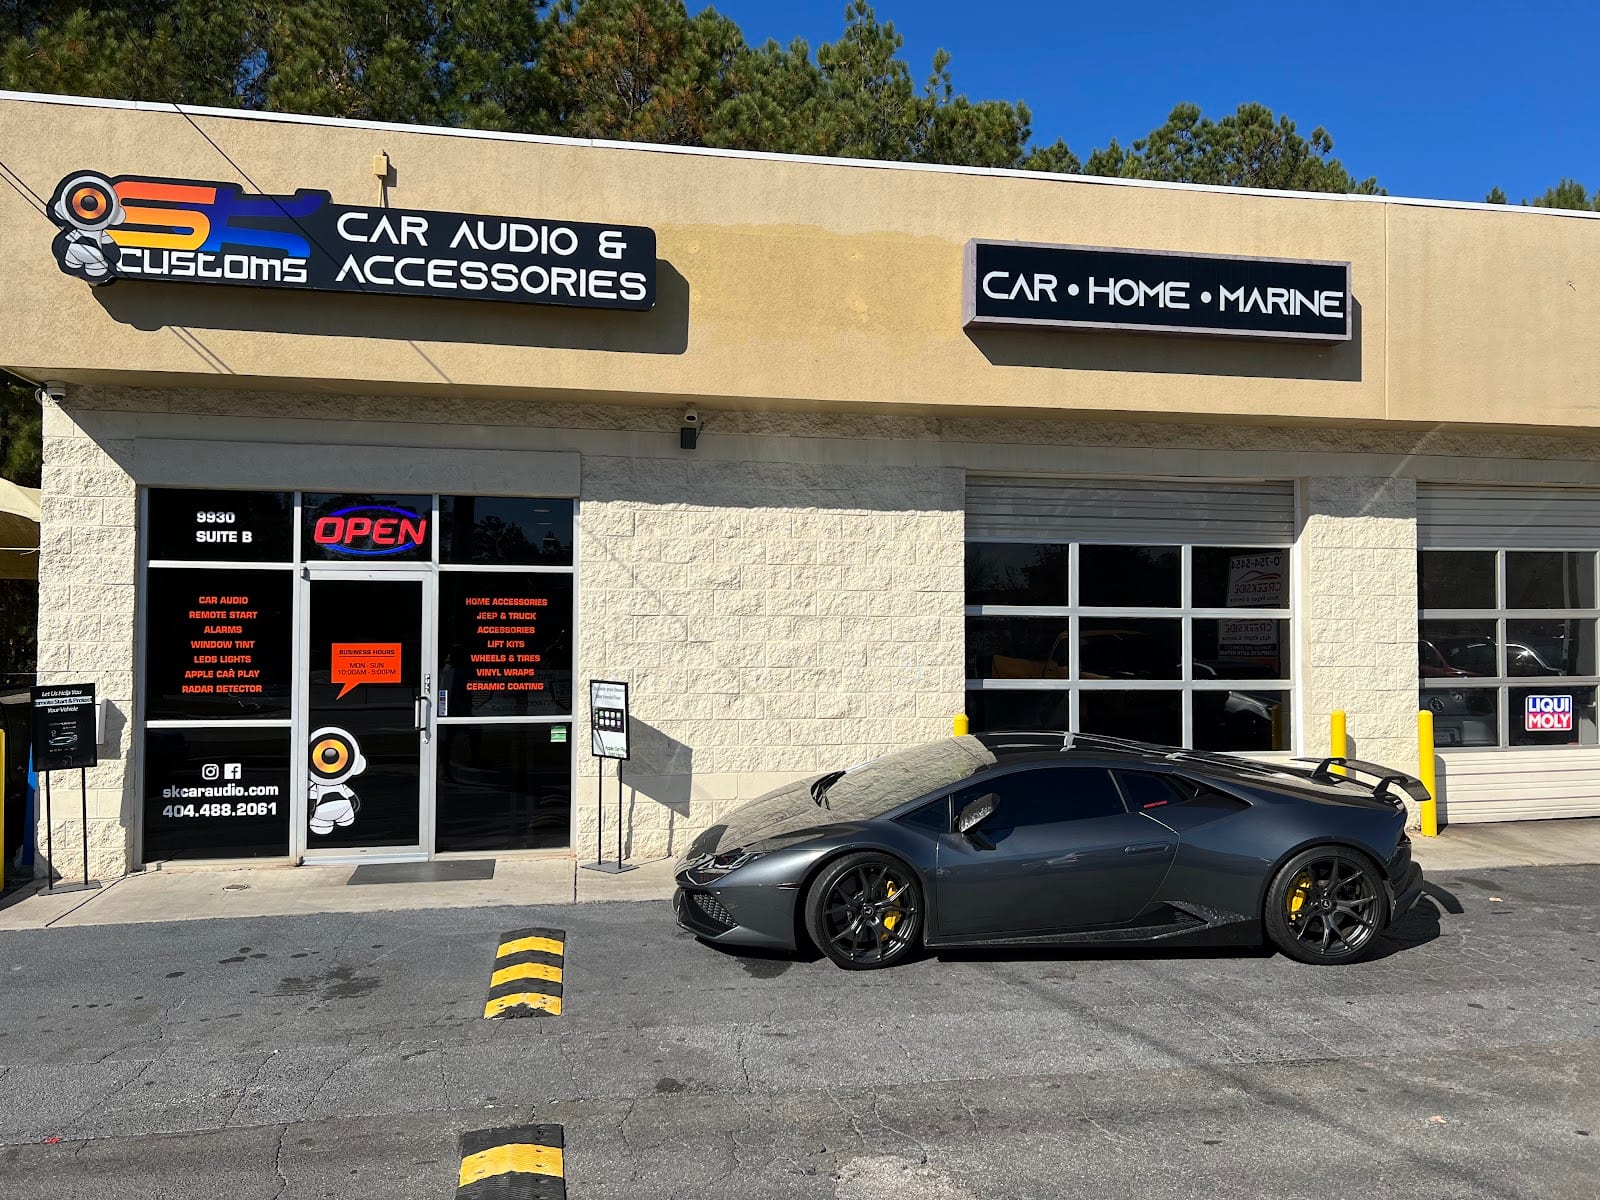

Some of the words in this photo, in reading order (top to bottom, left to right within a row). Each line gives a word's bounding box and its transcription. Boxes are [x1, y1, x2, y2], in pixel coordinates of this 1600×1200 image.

[337, 212, 428, 246] CAR
[450, 220, 578, 255] AUDIO
[599, 231, 626, 259] &
[336, 254, 647, 300] ACCESSORIES
[983, 271, 1057, 302] CAR
[1089, 277, 1189, 309] HOME
[1220, 285, 1343, 318] MARINE
[197, 512, 235, 523] 9930
[314, 517, 427, 544] OPEN
[196, 531, 237, 542] SUITE
[242, 531, 252, 542] B
[198, 596, 218, 605] CAR
[219, 596, 249, 605] AUDIO
[465, 597, 491, 606] HOME
[491, 597, 548, 607] ACCESSORIES
[188, 610, 227, 619] REMOTE
[229, 610, 258, 619] START
[476, 611, 498, 620] JEEP
[500, 612, 506, 620] &
[508, 612, 537, 620] TRUCK
[203, 625, 243, 634] ALARMS
[476, 626, 536, 634] ACCESSORIES
[190, 640, 233, 649] WINDOW
[234, 640, 256, 649] TINT
[487, 640, 505, 648] LIFT
[506, 640, 525, 648] KITS
[193, 655, 218, 664] LEDS
[219, 655, 252, 664] LIGHTS
[470, 654, 507, 663] WHEELS
[509, 654, 514, 663] &
[516, 654, 541, 663] TIRES
[184, 670, 214, 679] APPLE
[216, 668, 236, 678] CAR
[237, 669, 260, 678] PLAY
[476, 668, 502, 677] VINYL
[503, 668, 535, 677] WRAPS
[181, 684, 214, 694] RADAR
[215, 684, 263, 693] DETECTOR
[466, 682, 506, 691] CERAMIC
[507, 682, 544, 691] COATING
[1529, 698, 1569, 713] LIQUI
[1529, 714, 1569, 728] MOLY
[163, 783, 278, 797] skcaraudio.com
[163, 802, 276, 817] 404.488.2061
